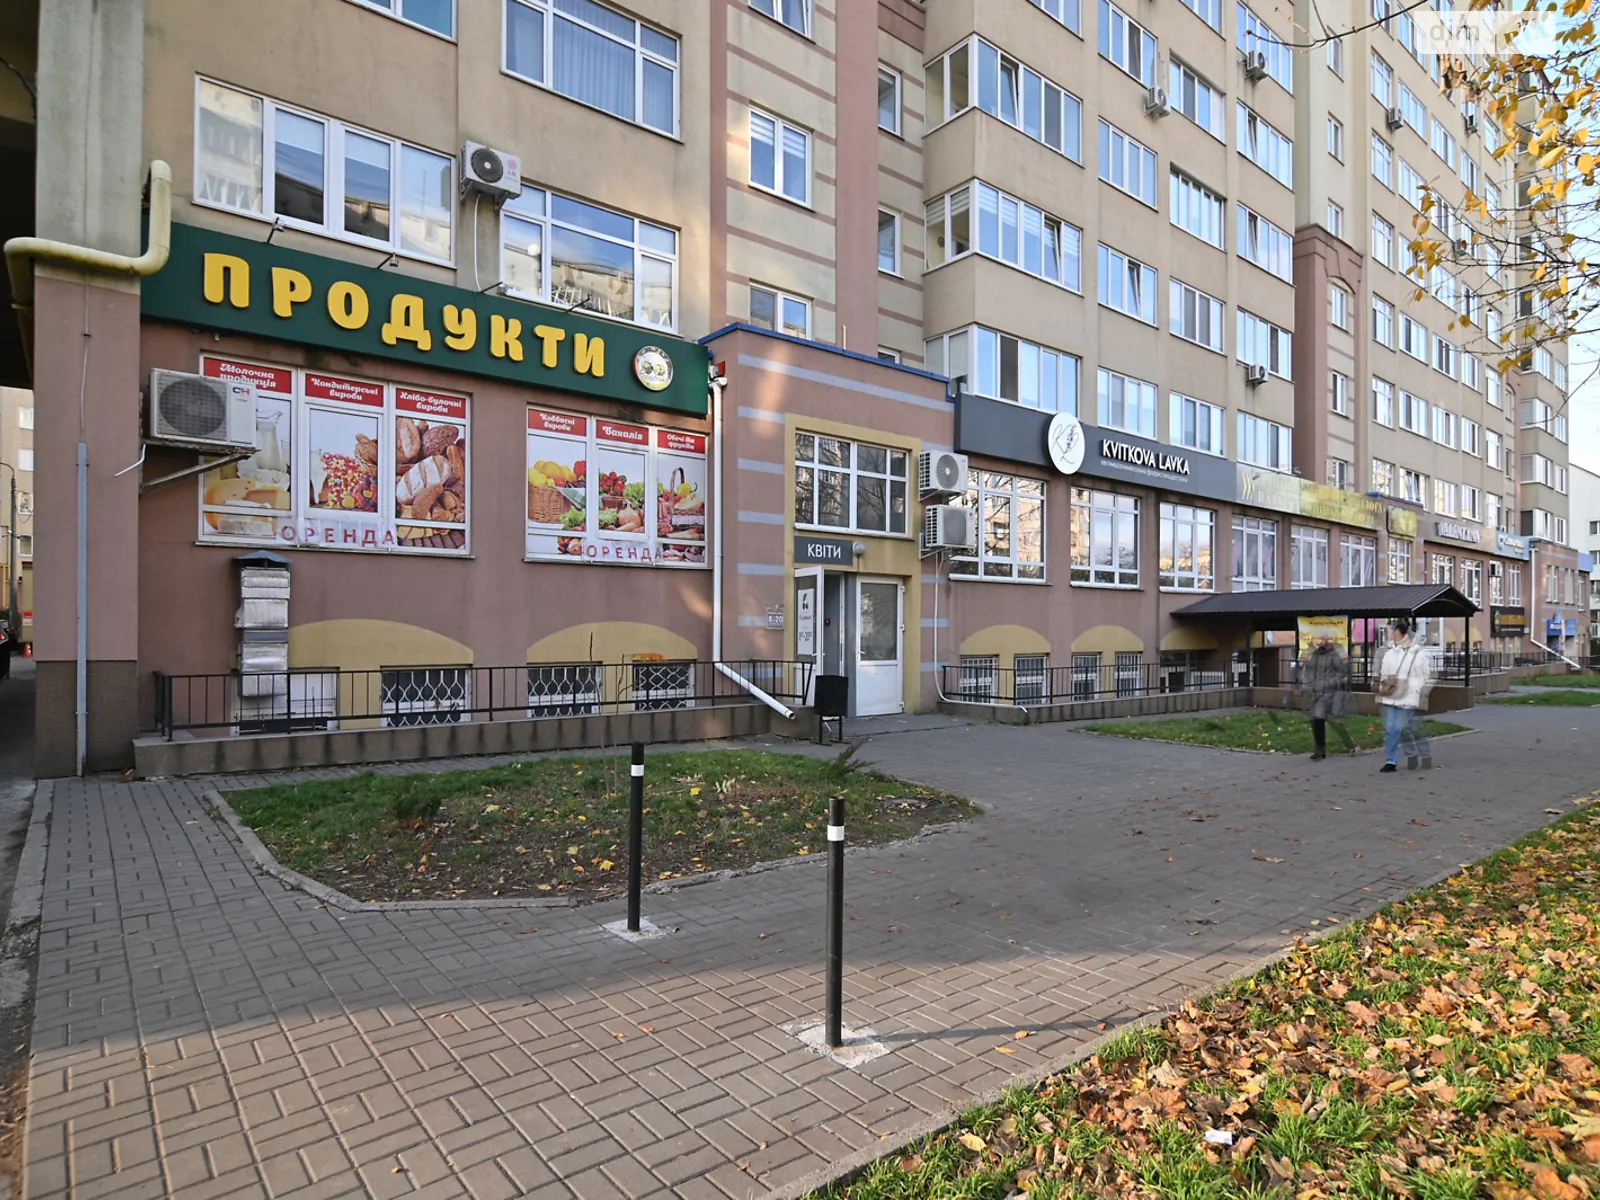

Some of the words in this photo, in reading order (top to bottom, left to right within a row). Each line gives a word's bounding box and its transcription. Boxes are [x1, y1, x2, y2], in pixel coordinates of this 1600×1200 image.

[203, 252, 605, 378] ПРОДУКТИ
[219, 363, 275, 380] Молочна
[310, 377, 379, 396] Кондитерські
[602, 426, 643, 441] Бакалія
[1101, 439, 1157, 468] KVITKOVA
[1158, 452, 1190, 475] LAVKA
[280, 525, 395, 547] ОРЕНДА
[586, 545, 664, 562] ОРЕНДА
[807, 543, 842, 559] КВІТИ
